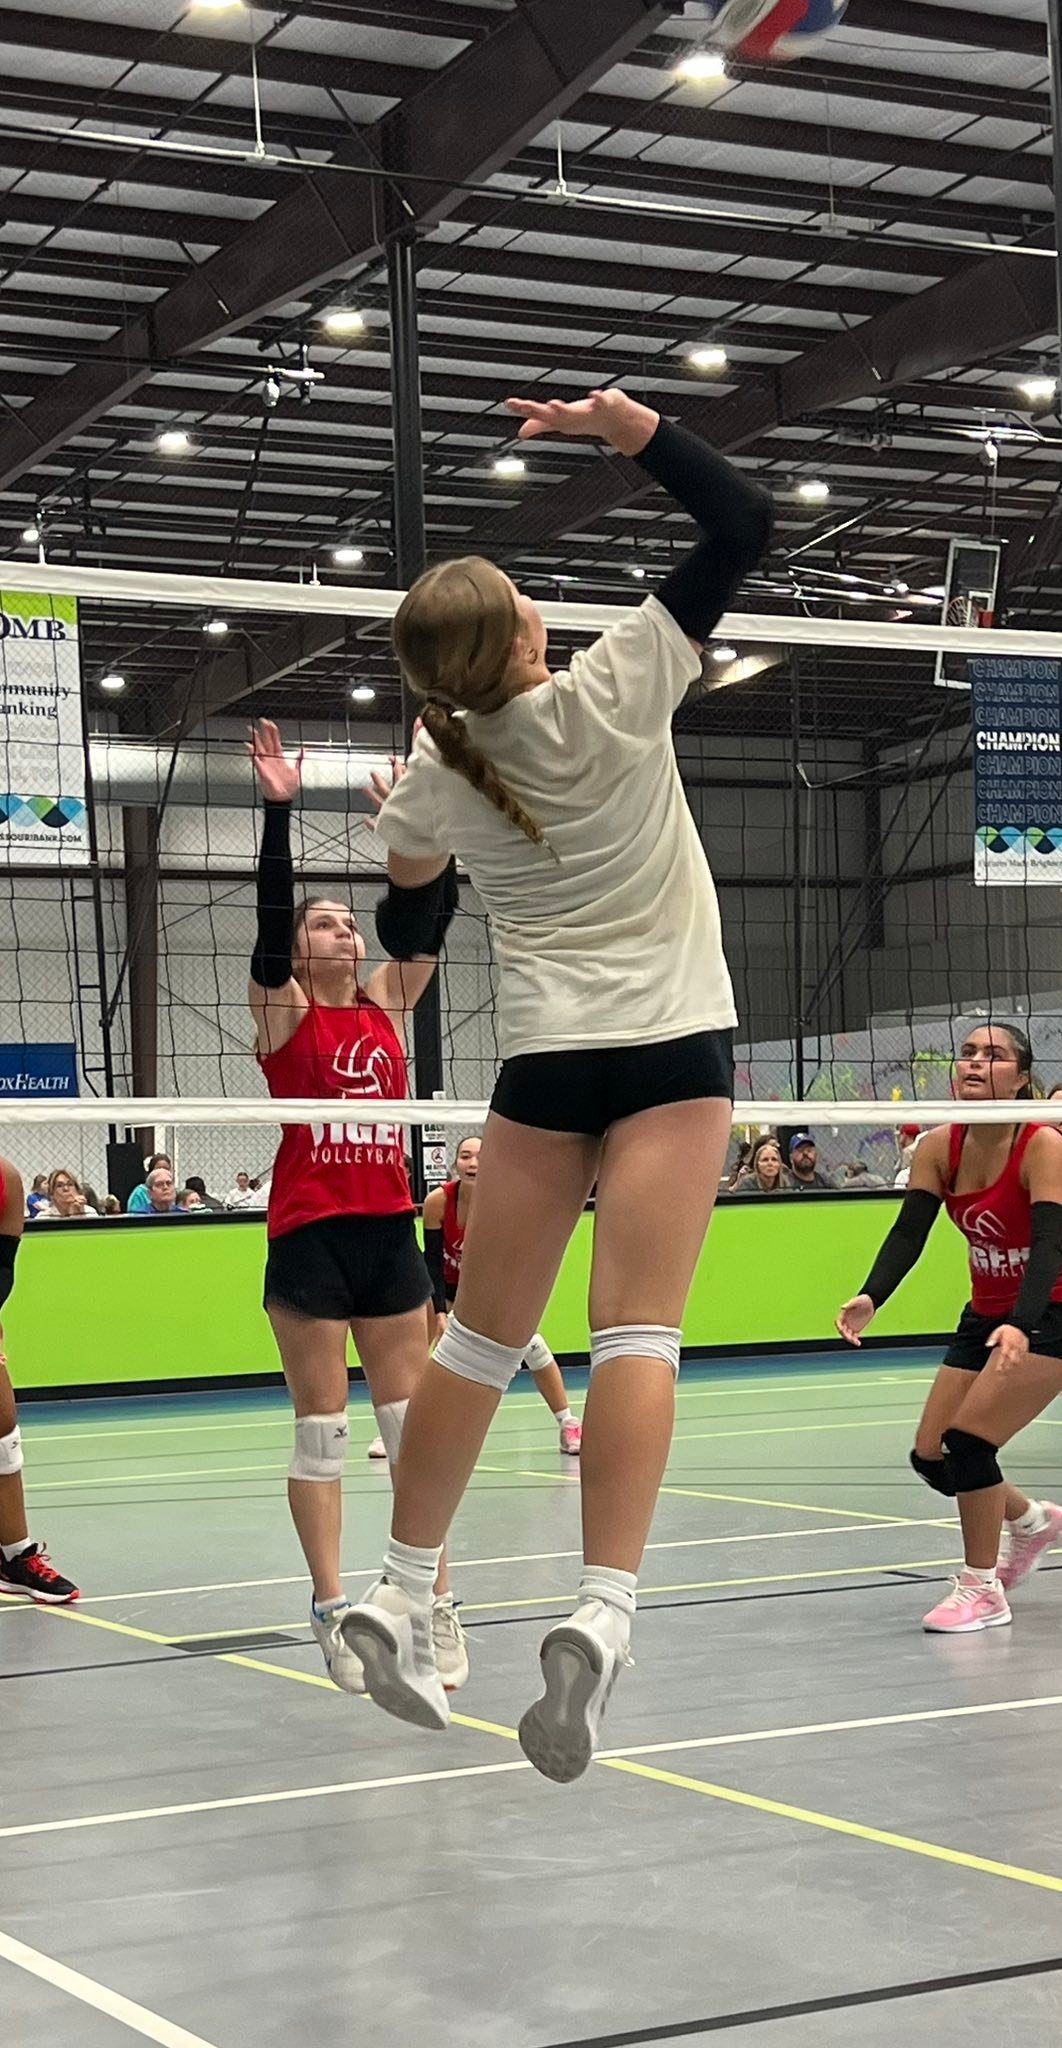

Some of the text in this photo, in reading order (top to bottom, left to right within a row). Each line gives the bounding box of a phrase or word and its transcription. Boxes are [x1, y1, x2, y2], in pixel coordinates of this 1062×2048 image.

[973, 658, 1059, 680] CHAMPION
[974, 682, 1060, 704] CHAMPION
[975, 706, 1060, 729] CHAMPION
[976, 731, 1060, 752] CHAMPION
[976, 755, 1061, 776] CHAMPION
[977, 779, 1062, 800] CHAMPION
[977, 803, 1062, 824] CHAMPION
[311, 1146, 399, 1165] VOLLEYBA
